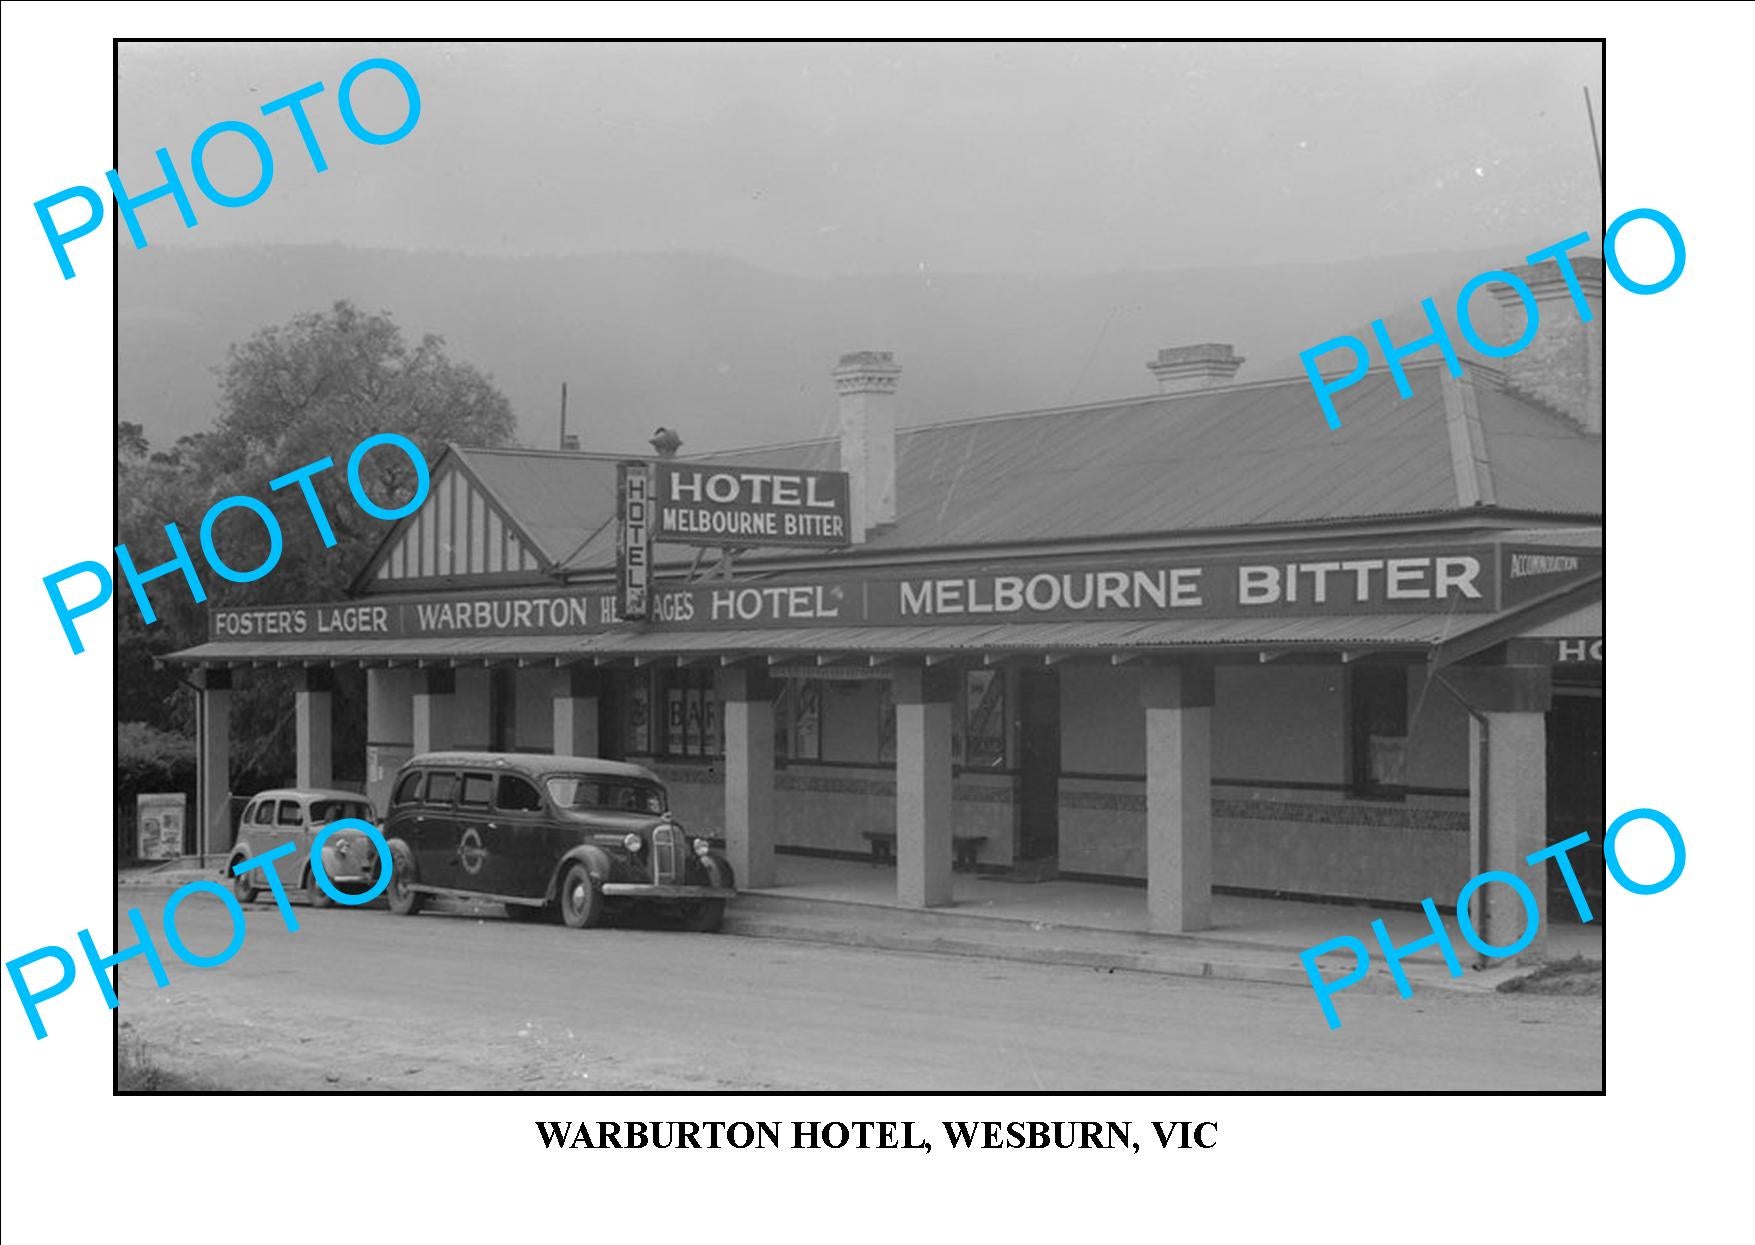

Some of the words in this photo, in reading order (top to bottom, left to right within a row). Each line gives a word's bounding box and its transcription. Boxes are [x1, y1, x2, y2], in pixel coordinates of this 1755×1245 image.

[670, 472, 836, 508] HOTEL
[628, 479, 645, 589] HOTEL
[663, 508, 778, 534] MELBOURNE
[784, 513, 844, 537] BITTER
[216, 609, 307, 635] FOSTER'S
[317, 606, 388, 632] LAGER
[417, 597, 588, 631] WARBURTON
[711, 585, 838, 620] HOTEL
[901, 568, 1203, 615] MELBOURNE
[1238, 556, 1483, 604] BITTER
